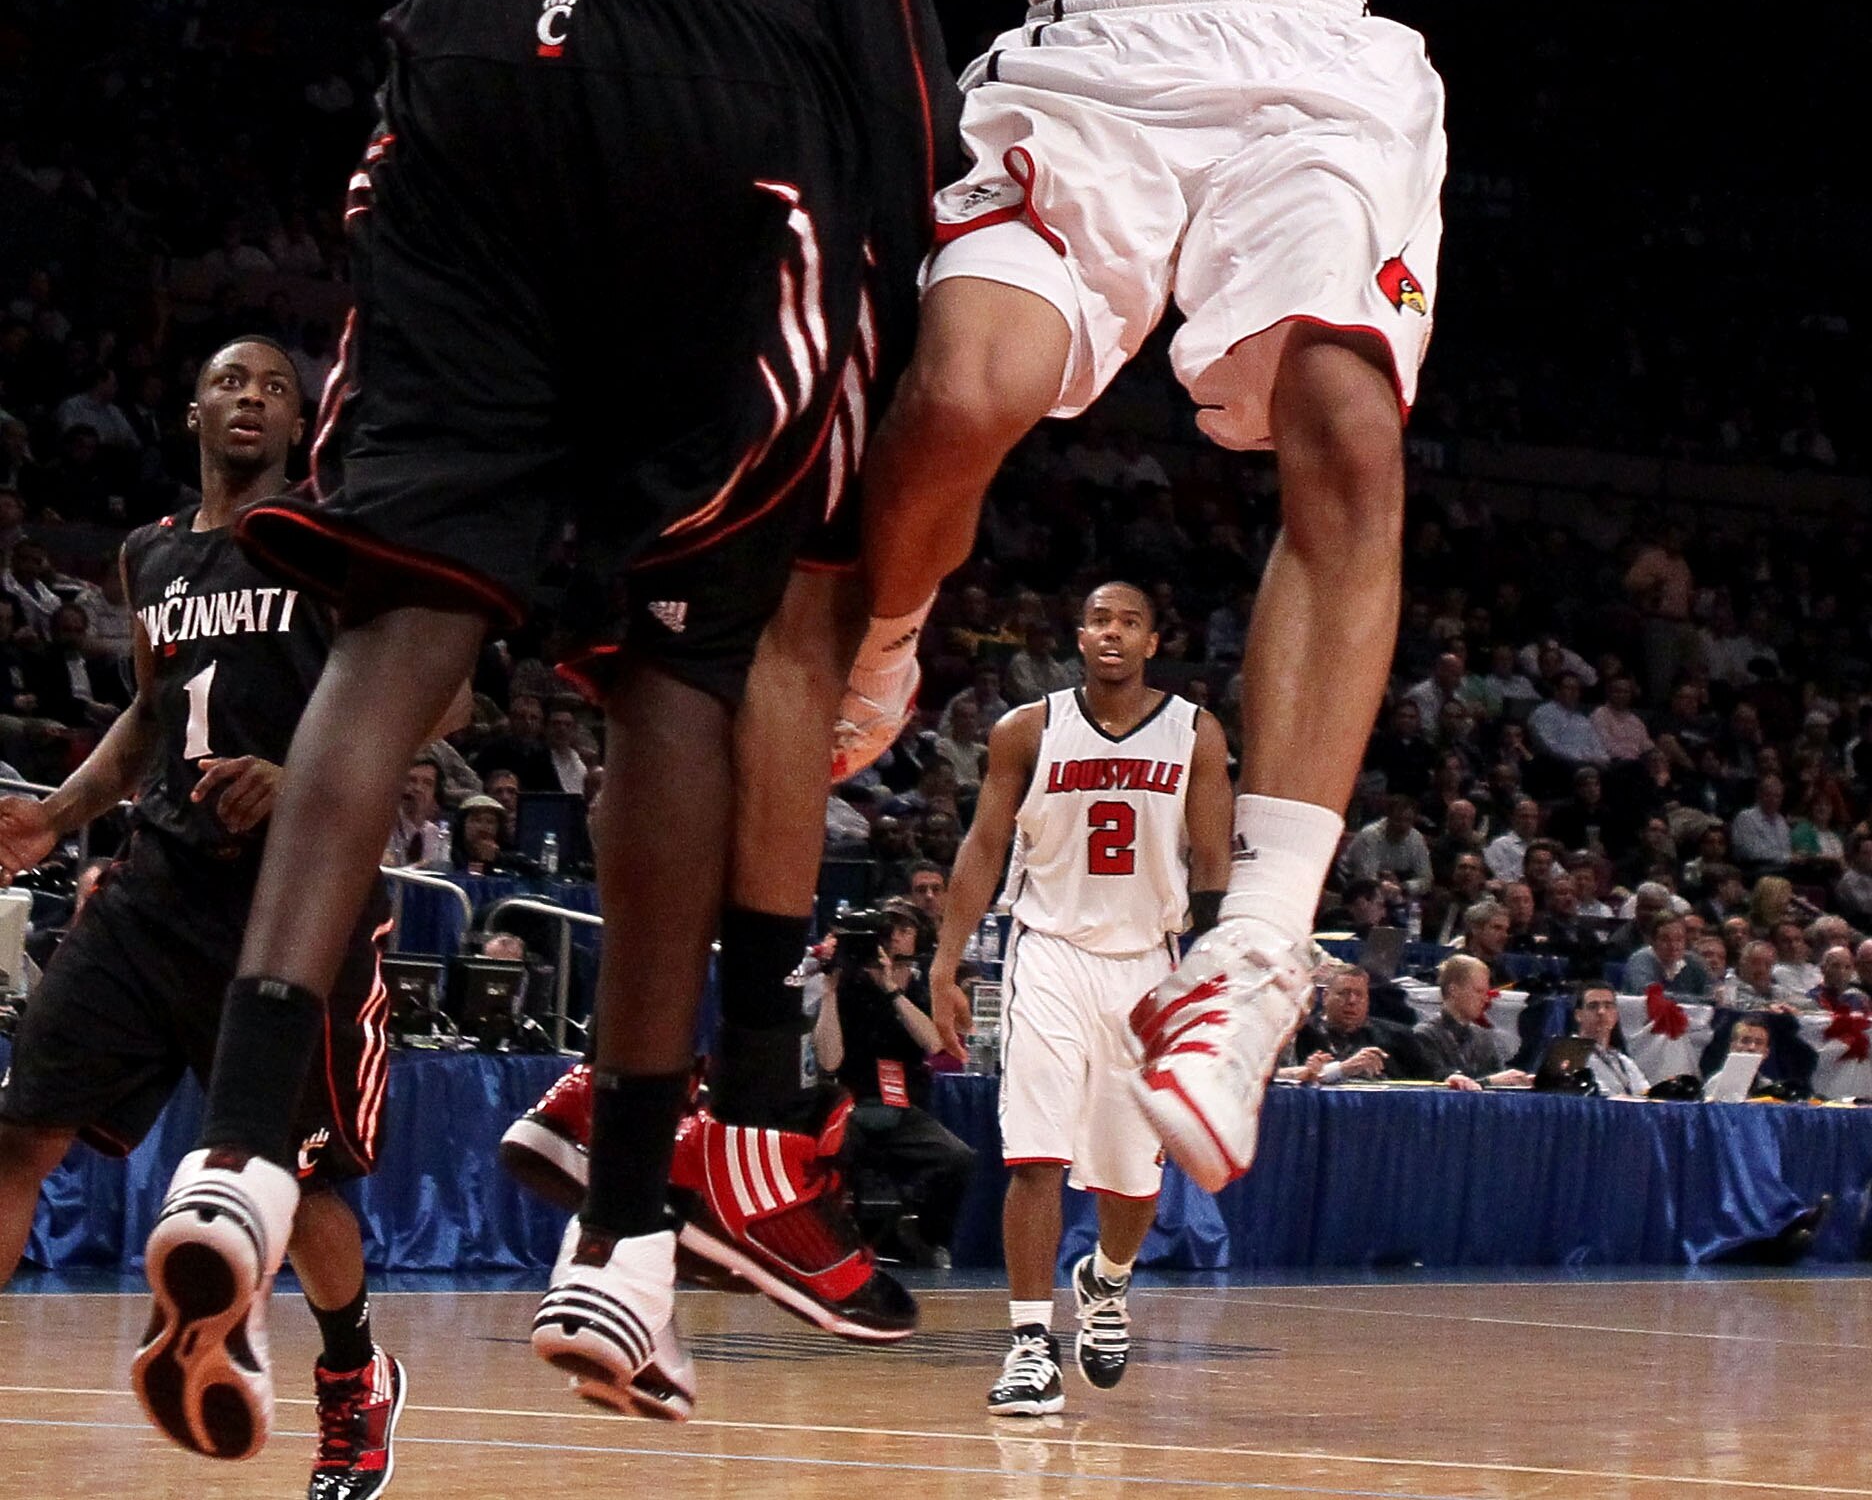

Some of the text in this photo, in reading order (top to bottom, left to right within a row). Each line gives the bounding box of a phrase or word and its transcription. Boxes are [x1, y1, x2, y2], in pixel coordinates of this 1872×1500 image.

[183, 659, 217, 761] 1
[1045, 758, 1184, 796] LOUISVILLE
[1088, 800, 1136, 876] 2
